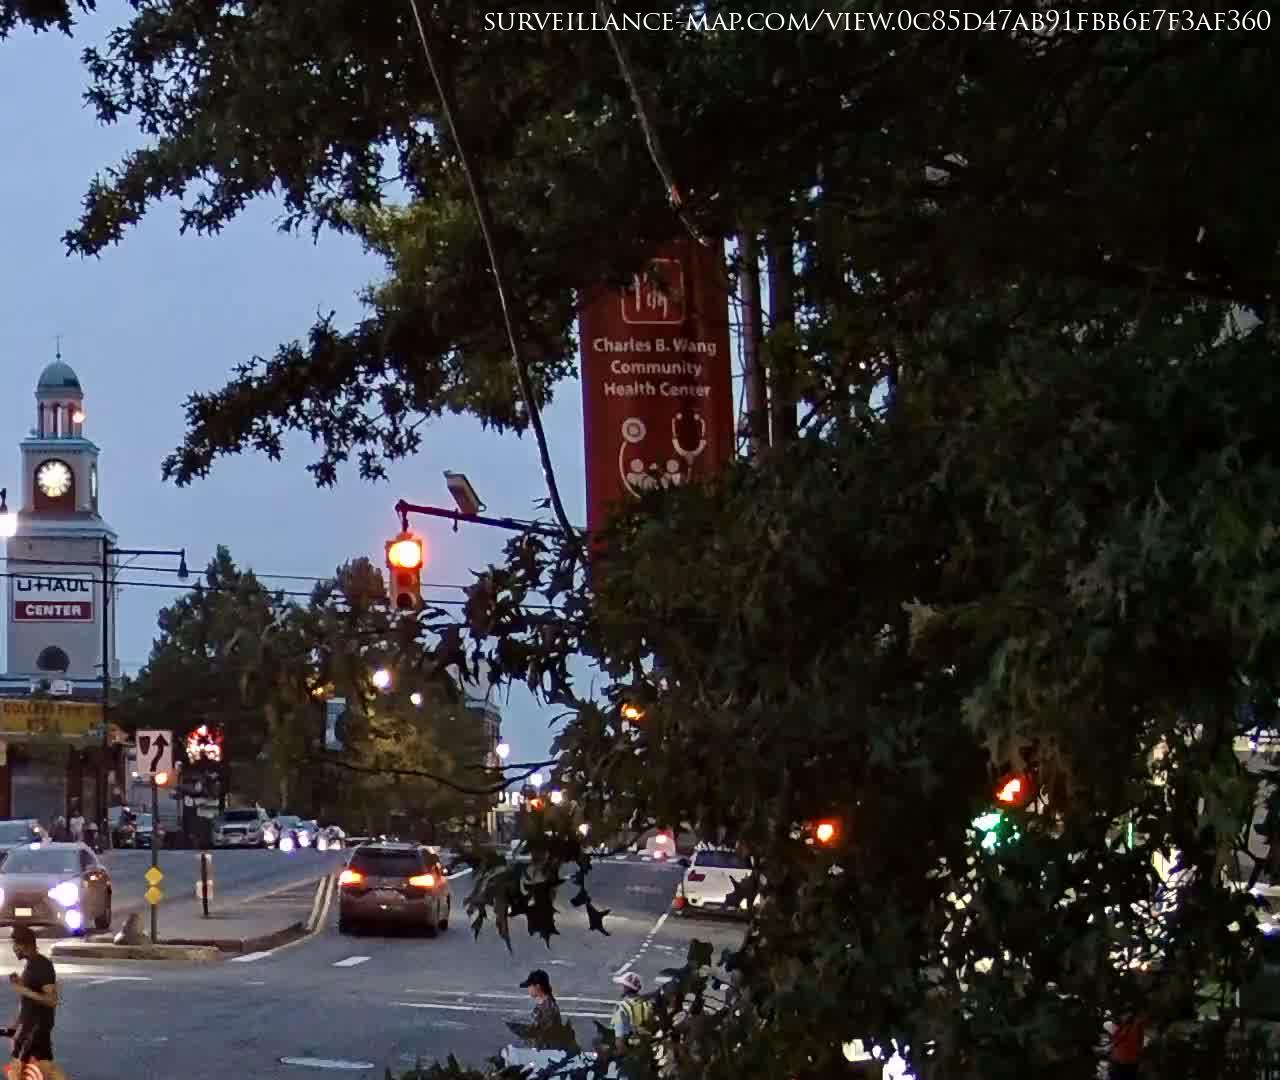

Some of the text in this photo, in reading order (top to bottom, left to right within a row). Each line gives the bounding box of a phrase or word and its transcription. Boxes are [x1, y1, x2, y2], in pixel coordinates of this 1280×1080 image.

[593, 337, 717, 357] Charles B. Wang
[610, 360, 703, 377] Community
[604, 381, 711, 397] Health Center
[24, 604, 82, 617] CENTER
